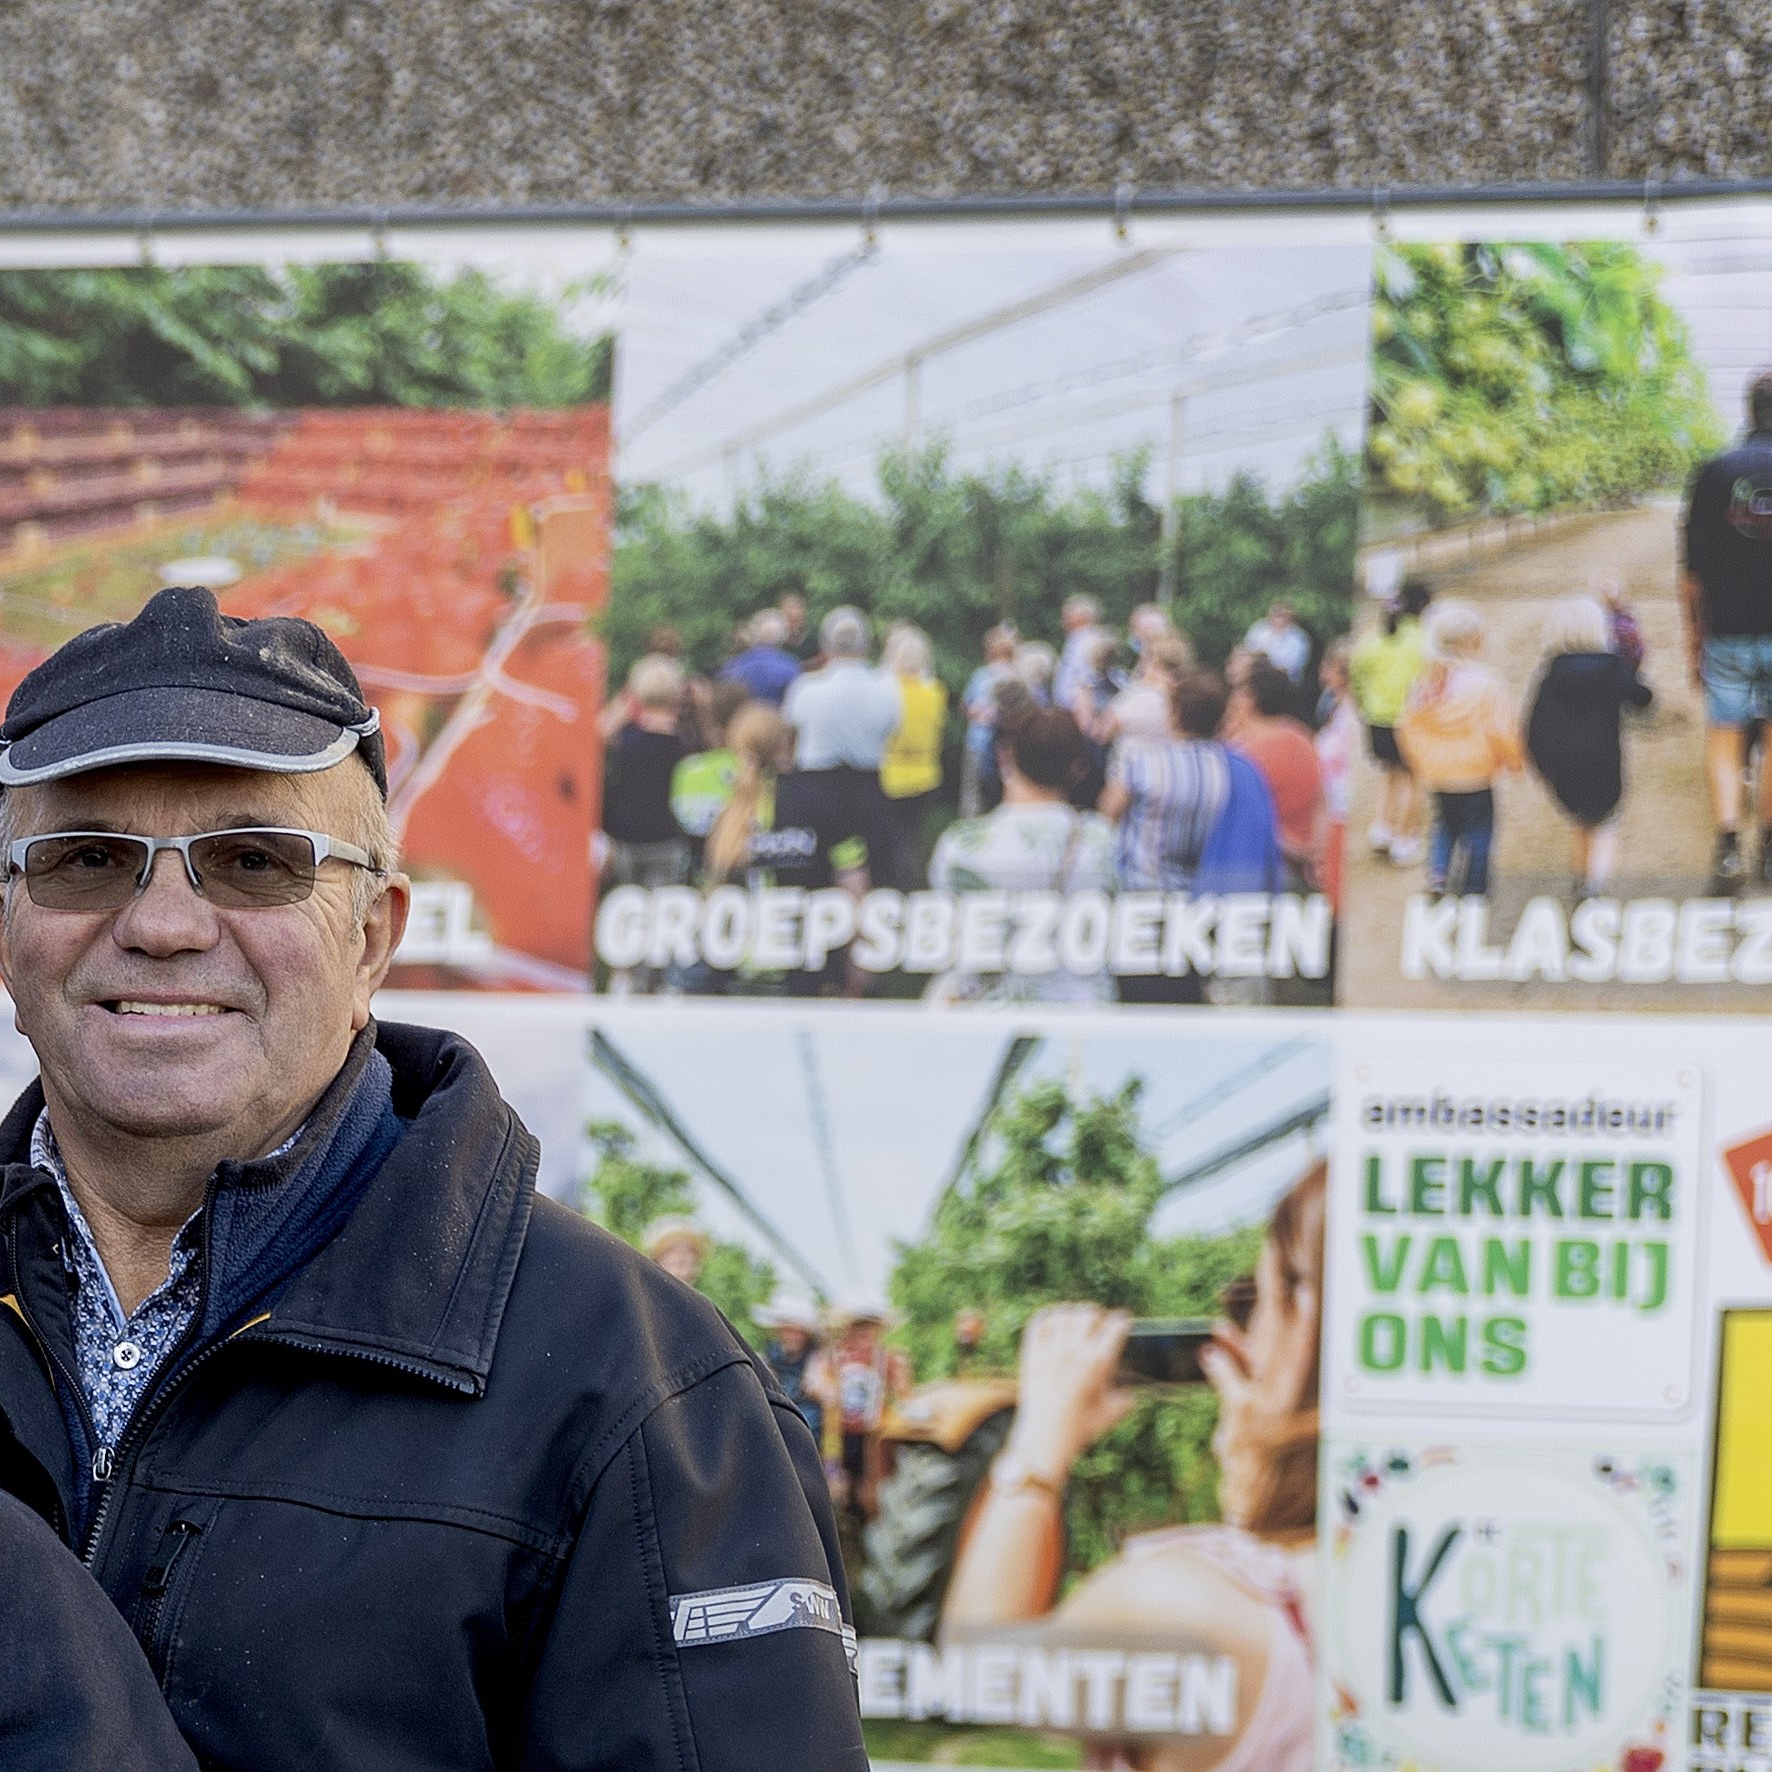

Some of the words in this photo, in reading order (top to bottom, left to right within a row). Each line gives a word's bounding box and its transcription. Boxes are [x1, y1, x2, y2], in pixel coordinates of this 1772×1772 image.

[595, 884, 1333, 980] GROEPSBEZOEKEN
[1366, 1088, 1675, 1132] ambassadeur
[1366, 1156, 1673, 1219] LEKKER
[1362, 1236, 1531, 1297] VAN
[1557, 1240, 1669, 1310] BIJ
[1361, 1314, 1526, 1374] ONS
